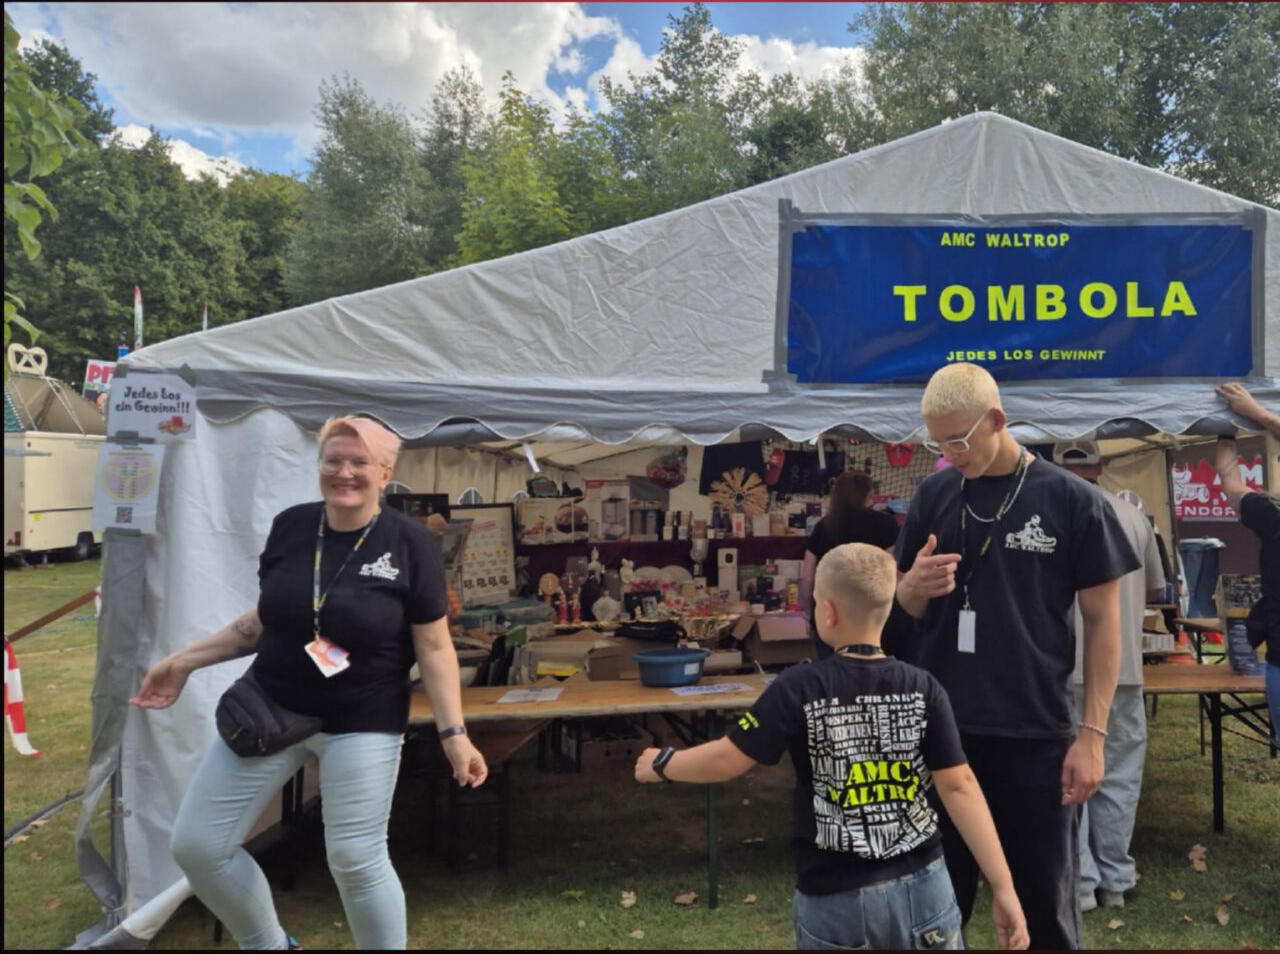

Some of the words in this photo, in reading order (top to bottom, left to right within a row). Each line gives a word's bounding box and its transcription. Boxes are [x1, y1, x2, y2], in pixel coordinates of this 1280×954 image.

[940, 232, 976, 247] AMC
[986, 233, 1070, 247] WALTROP
[893, 280, 1197, 322] TOMBOLA
[946, 350, 997, 361] JEDES
[1004, 350, 1033, 360] LOS
[1040, 349, 1106, 361] GEWINNT
[124, 386, 159, 400] Jedes
[115, 401, 132, 412] ein
[846, 760, 911, 786] AMC
